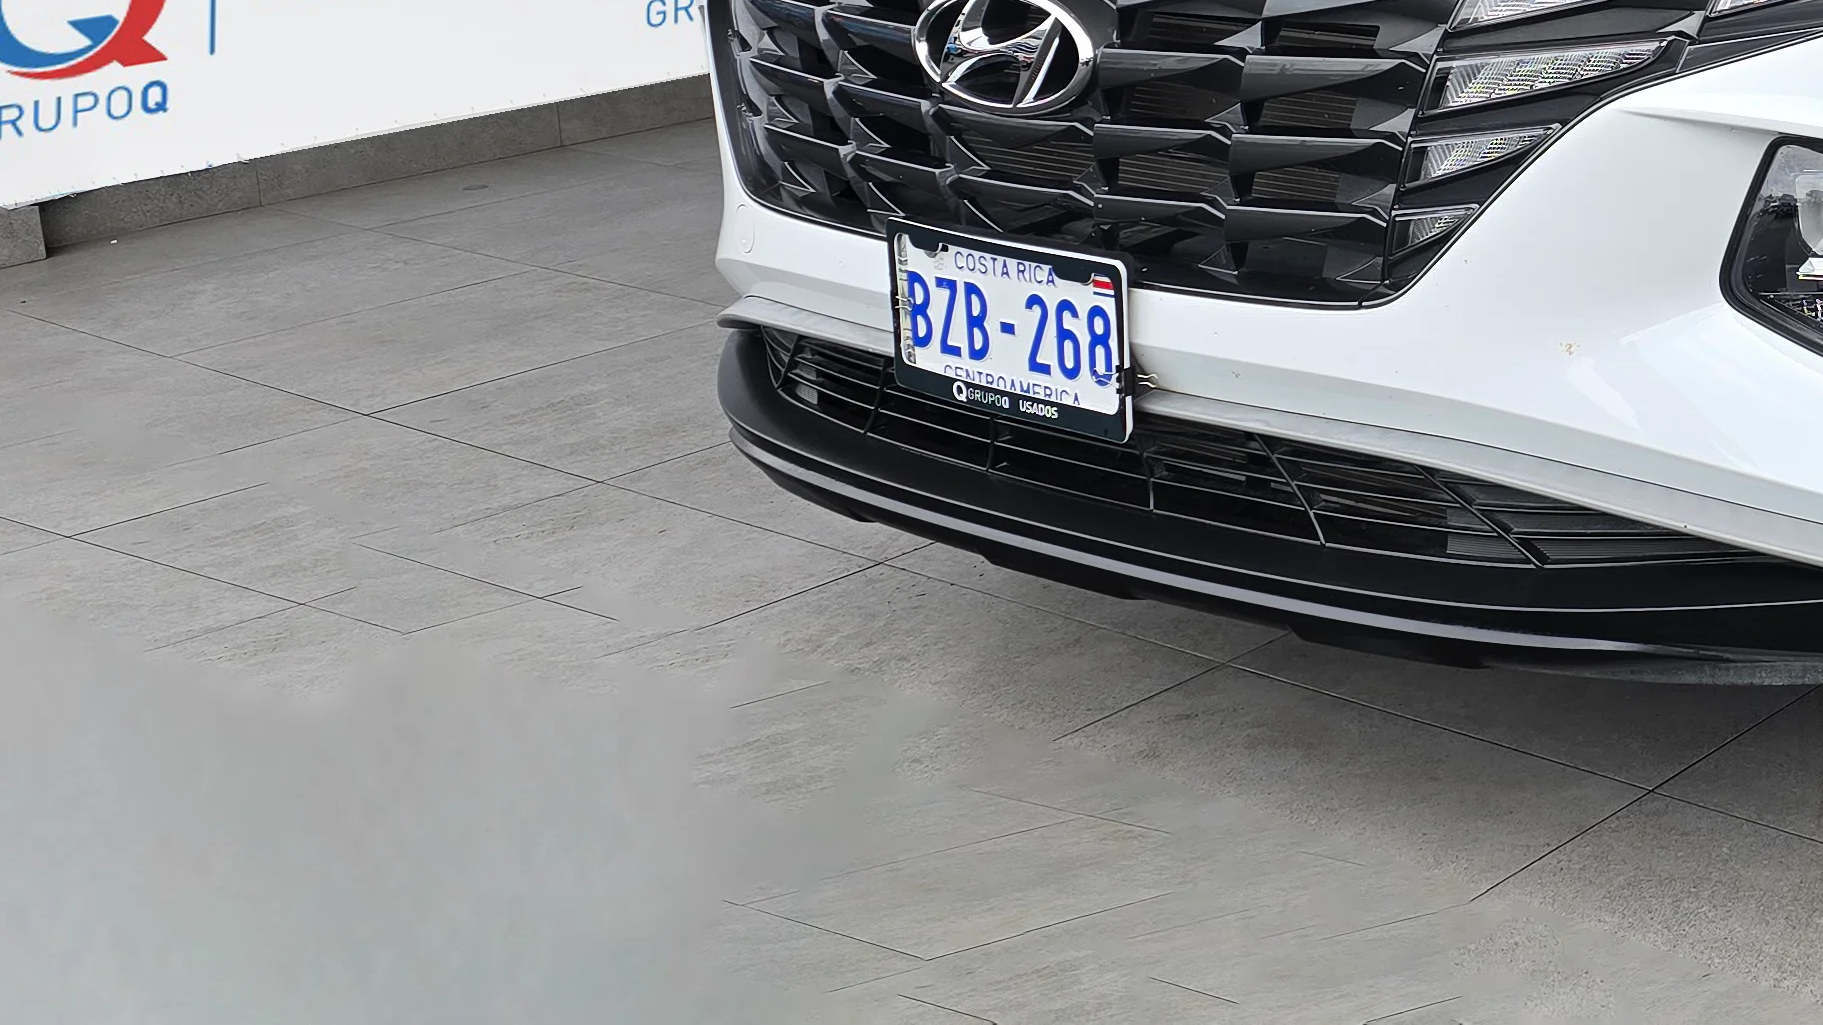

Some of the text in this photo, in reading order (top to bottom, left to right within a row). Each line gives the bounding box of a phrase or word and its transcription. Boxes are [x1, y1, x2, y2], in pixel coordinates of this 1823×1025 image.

[954, 250, 1011, 279] COSTA
[1017, 260, 1057, 287] RICA
[907, 270, 1113, 388] BZB-268
[1019, 399, 1059, 419] USADOS
